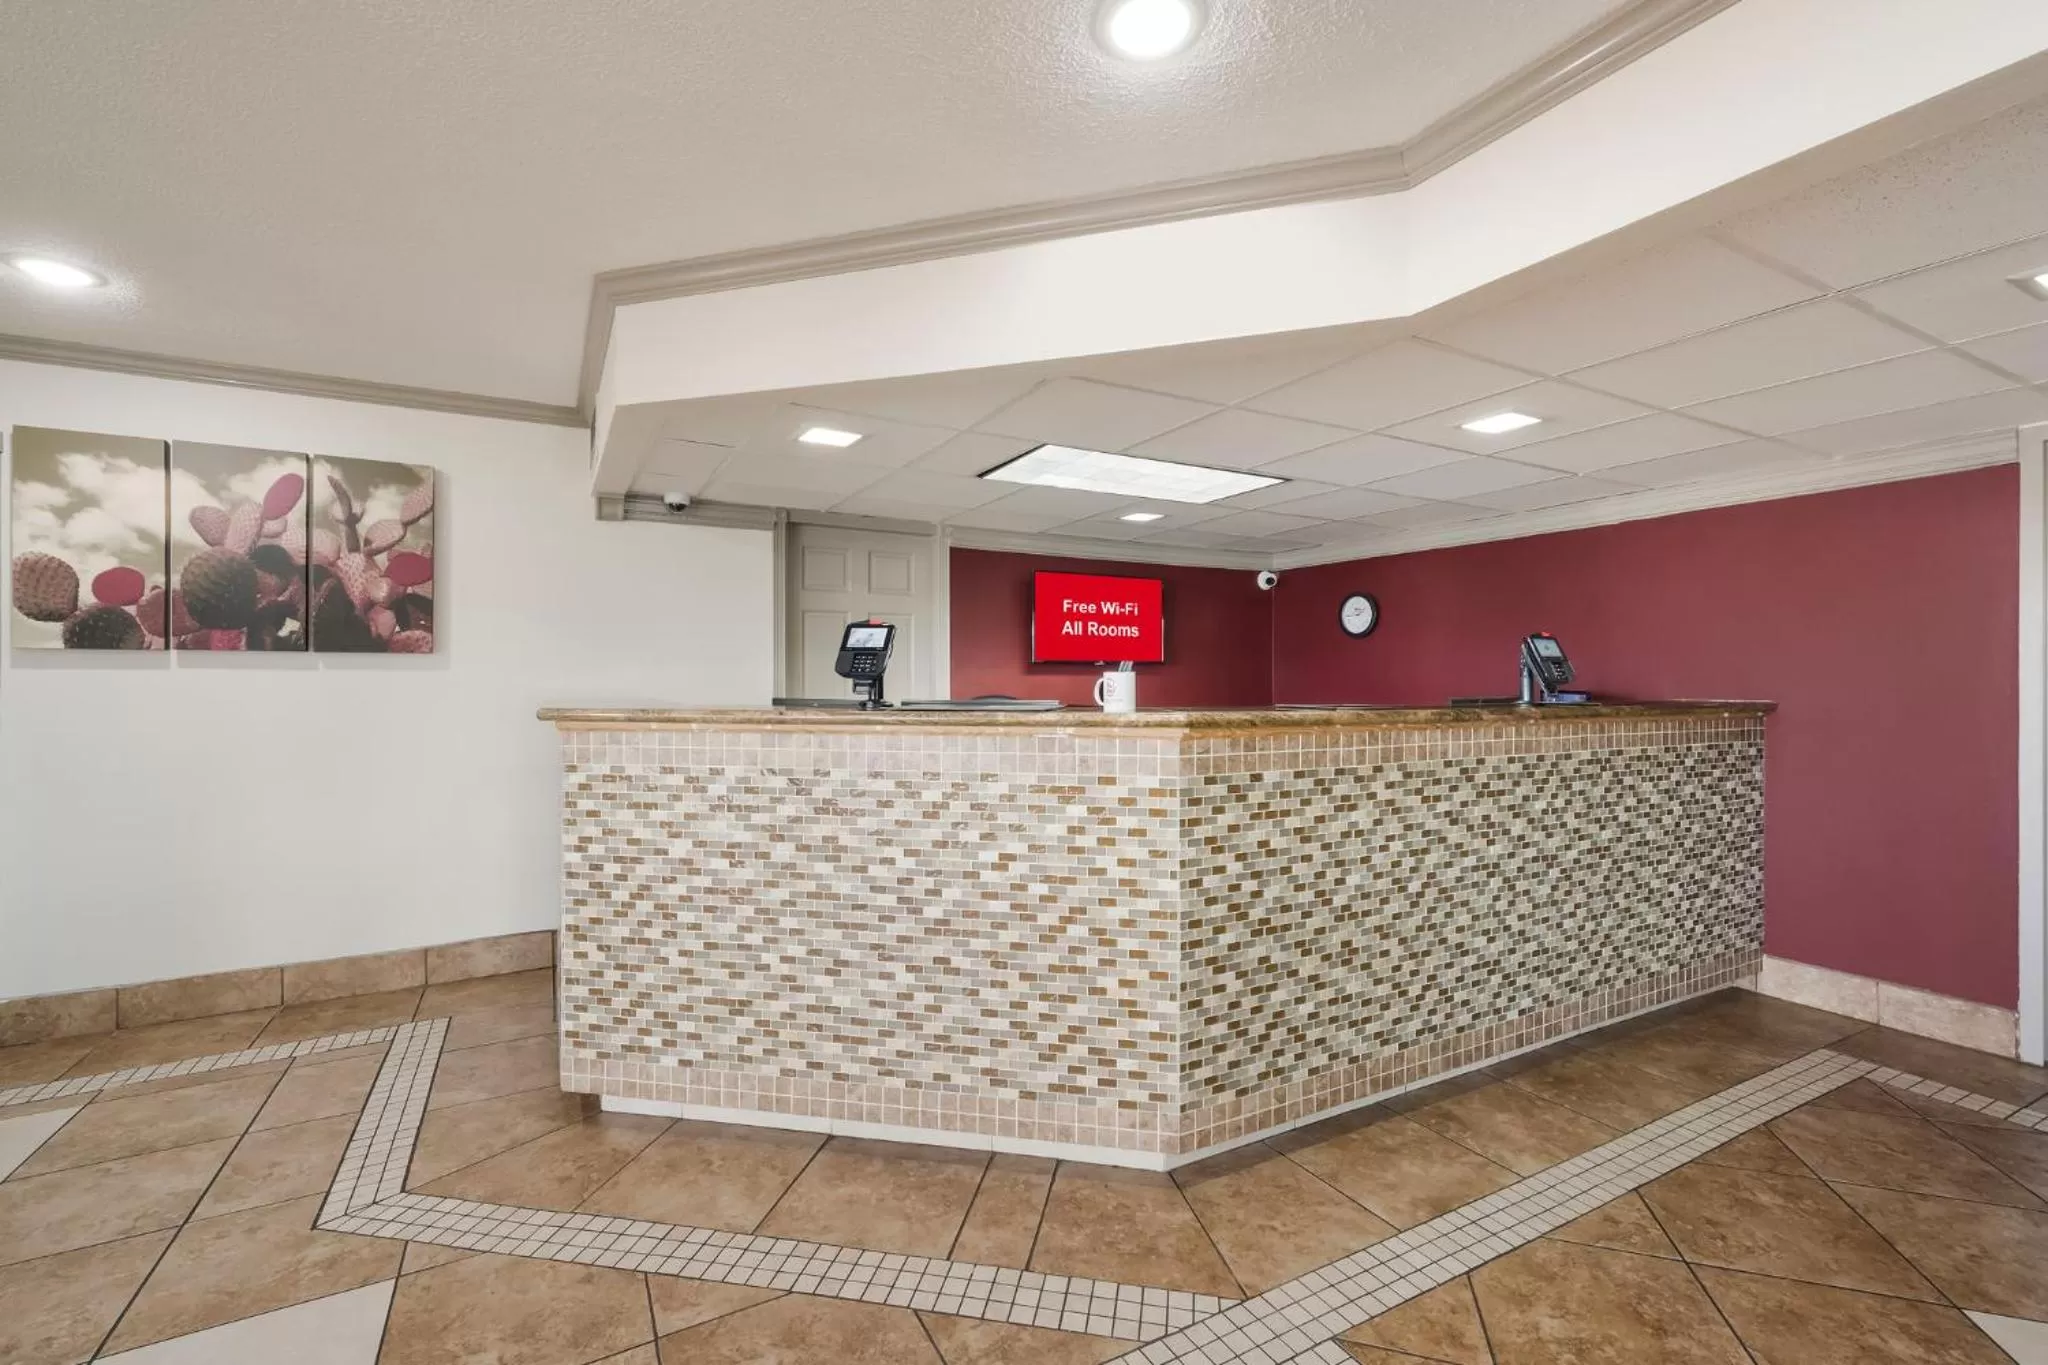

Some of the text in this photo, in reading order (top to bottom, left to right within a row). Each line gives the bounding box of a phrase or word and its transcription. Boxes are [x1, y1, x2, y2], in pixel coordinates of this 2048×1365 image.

[1062, 599, 1138, 616] Free Wi-Fi
[1061, 620, 1139, 638] All Rooms
